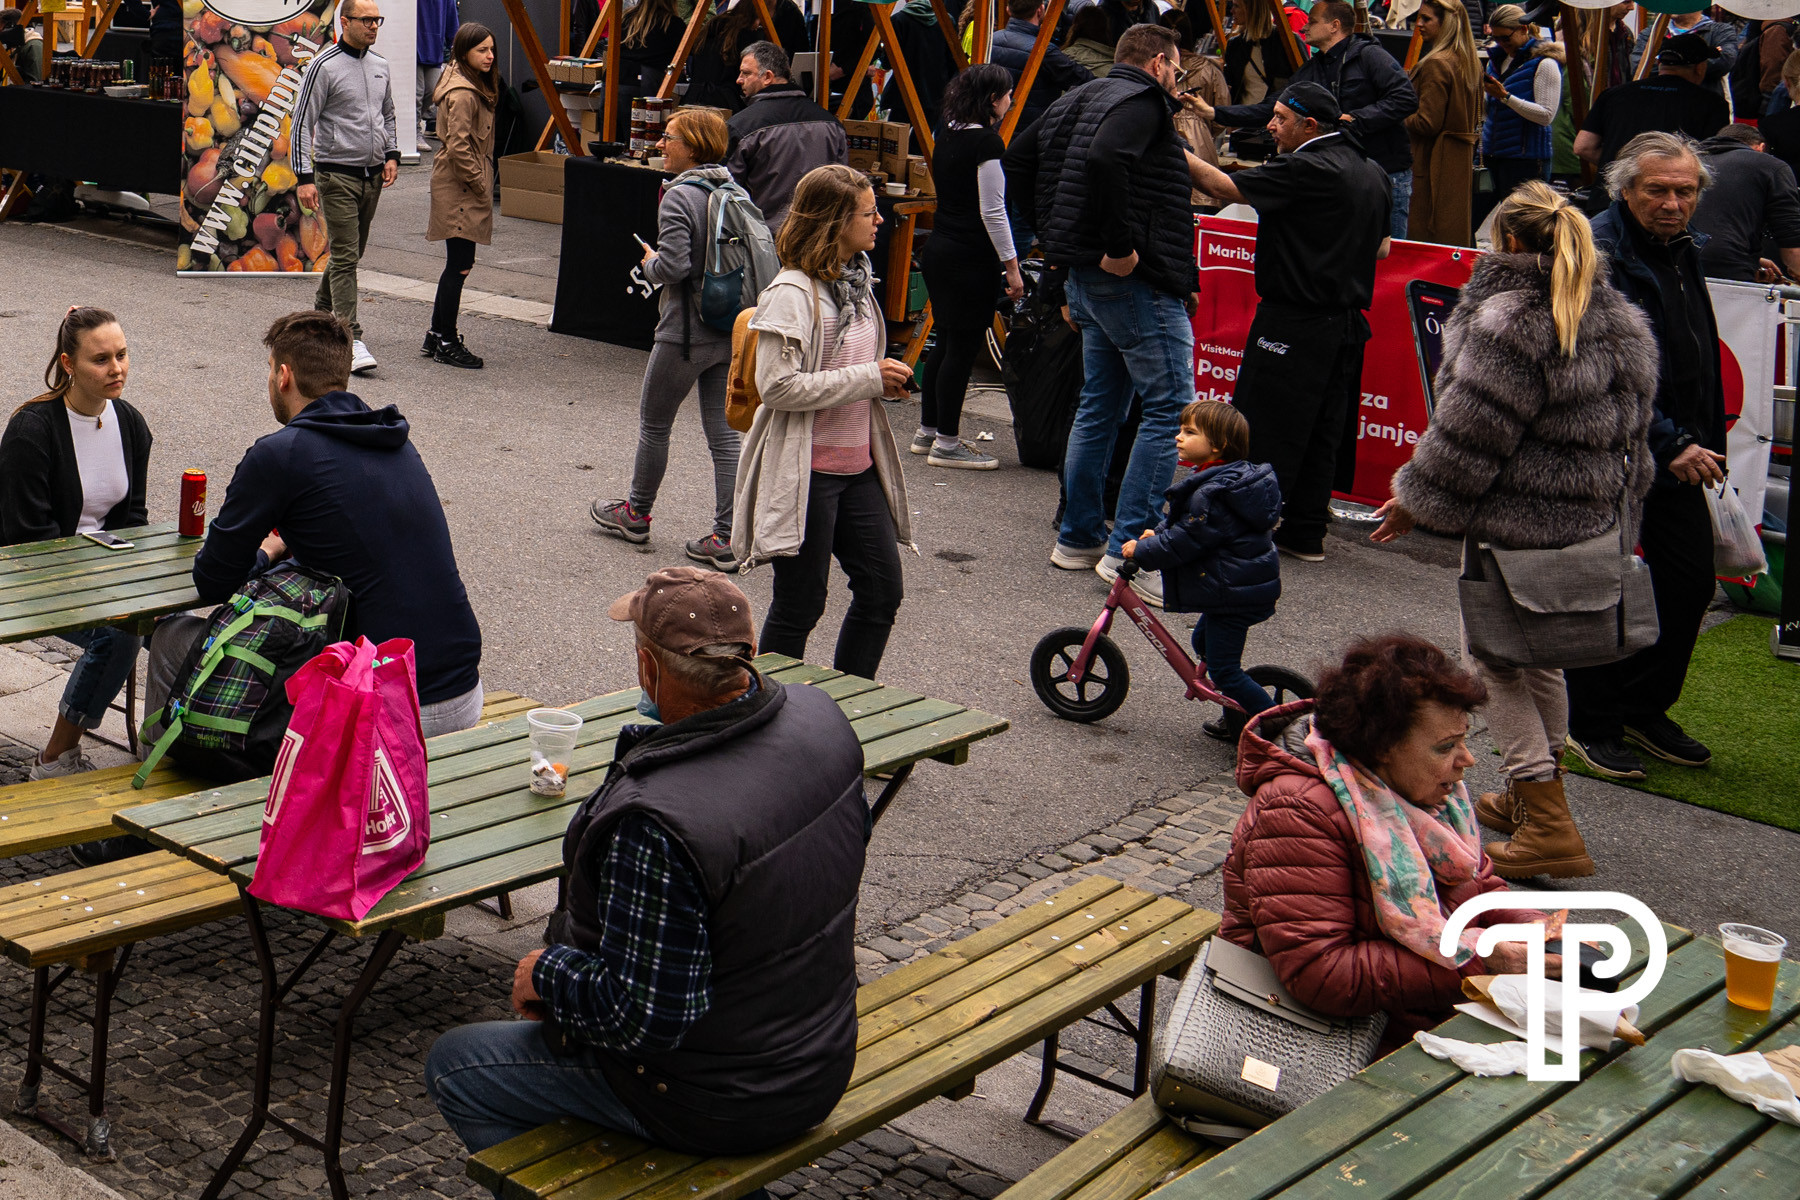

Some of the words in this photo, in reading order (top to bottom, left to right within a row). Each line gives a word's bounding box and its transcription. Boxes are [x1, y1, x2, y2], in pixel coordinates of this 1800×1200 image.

[1200, 343, 1244, 358] VisitMari
[1361, 392, 1388, 410] za
[1357, 416, 1419, 447] janje
[1132, 607, 1154, 626] BE
[1137, 621, 1168, 658] COOL
